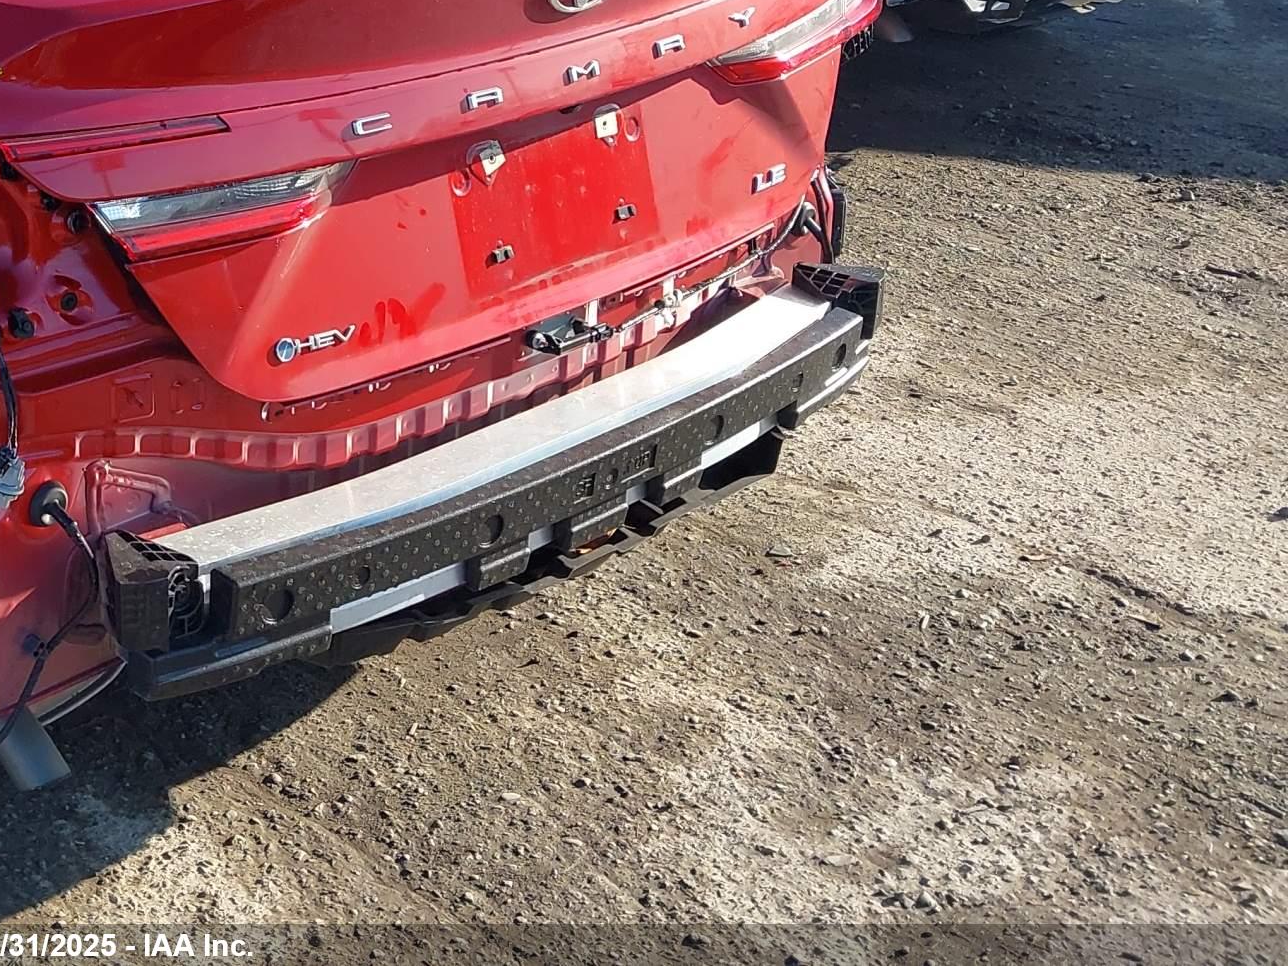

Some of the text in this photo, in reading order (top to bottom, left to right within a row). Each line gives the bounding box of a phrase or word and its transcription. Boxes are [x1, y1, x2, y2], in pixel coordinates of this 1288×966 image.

[352, 7, 756, 137] CAMRY
[751, 163, 787, 194] LE
[294, 324, 356, 354] HEV
